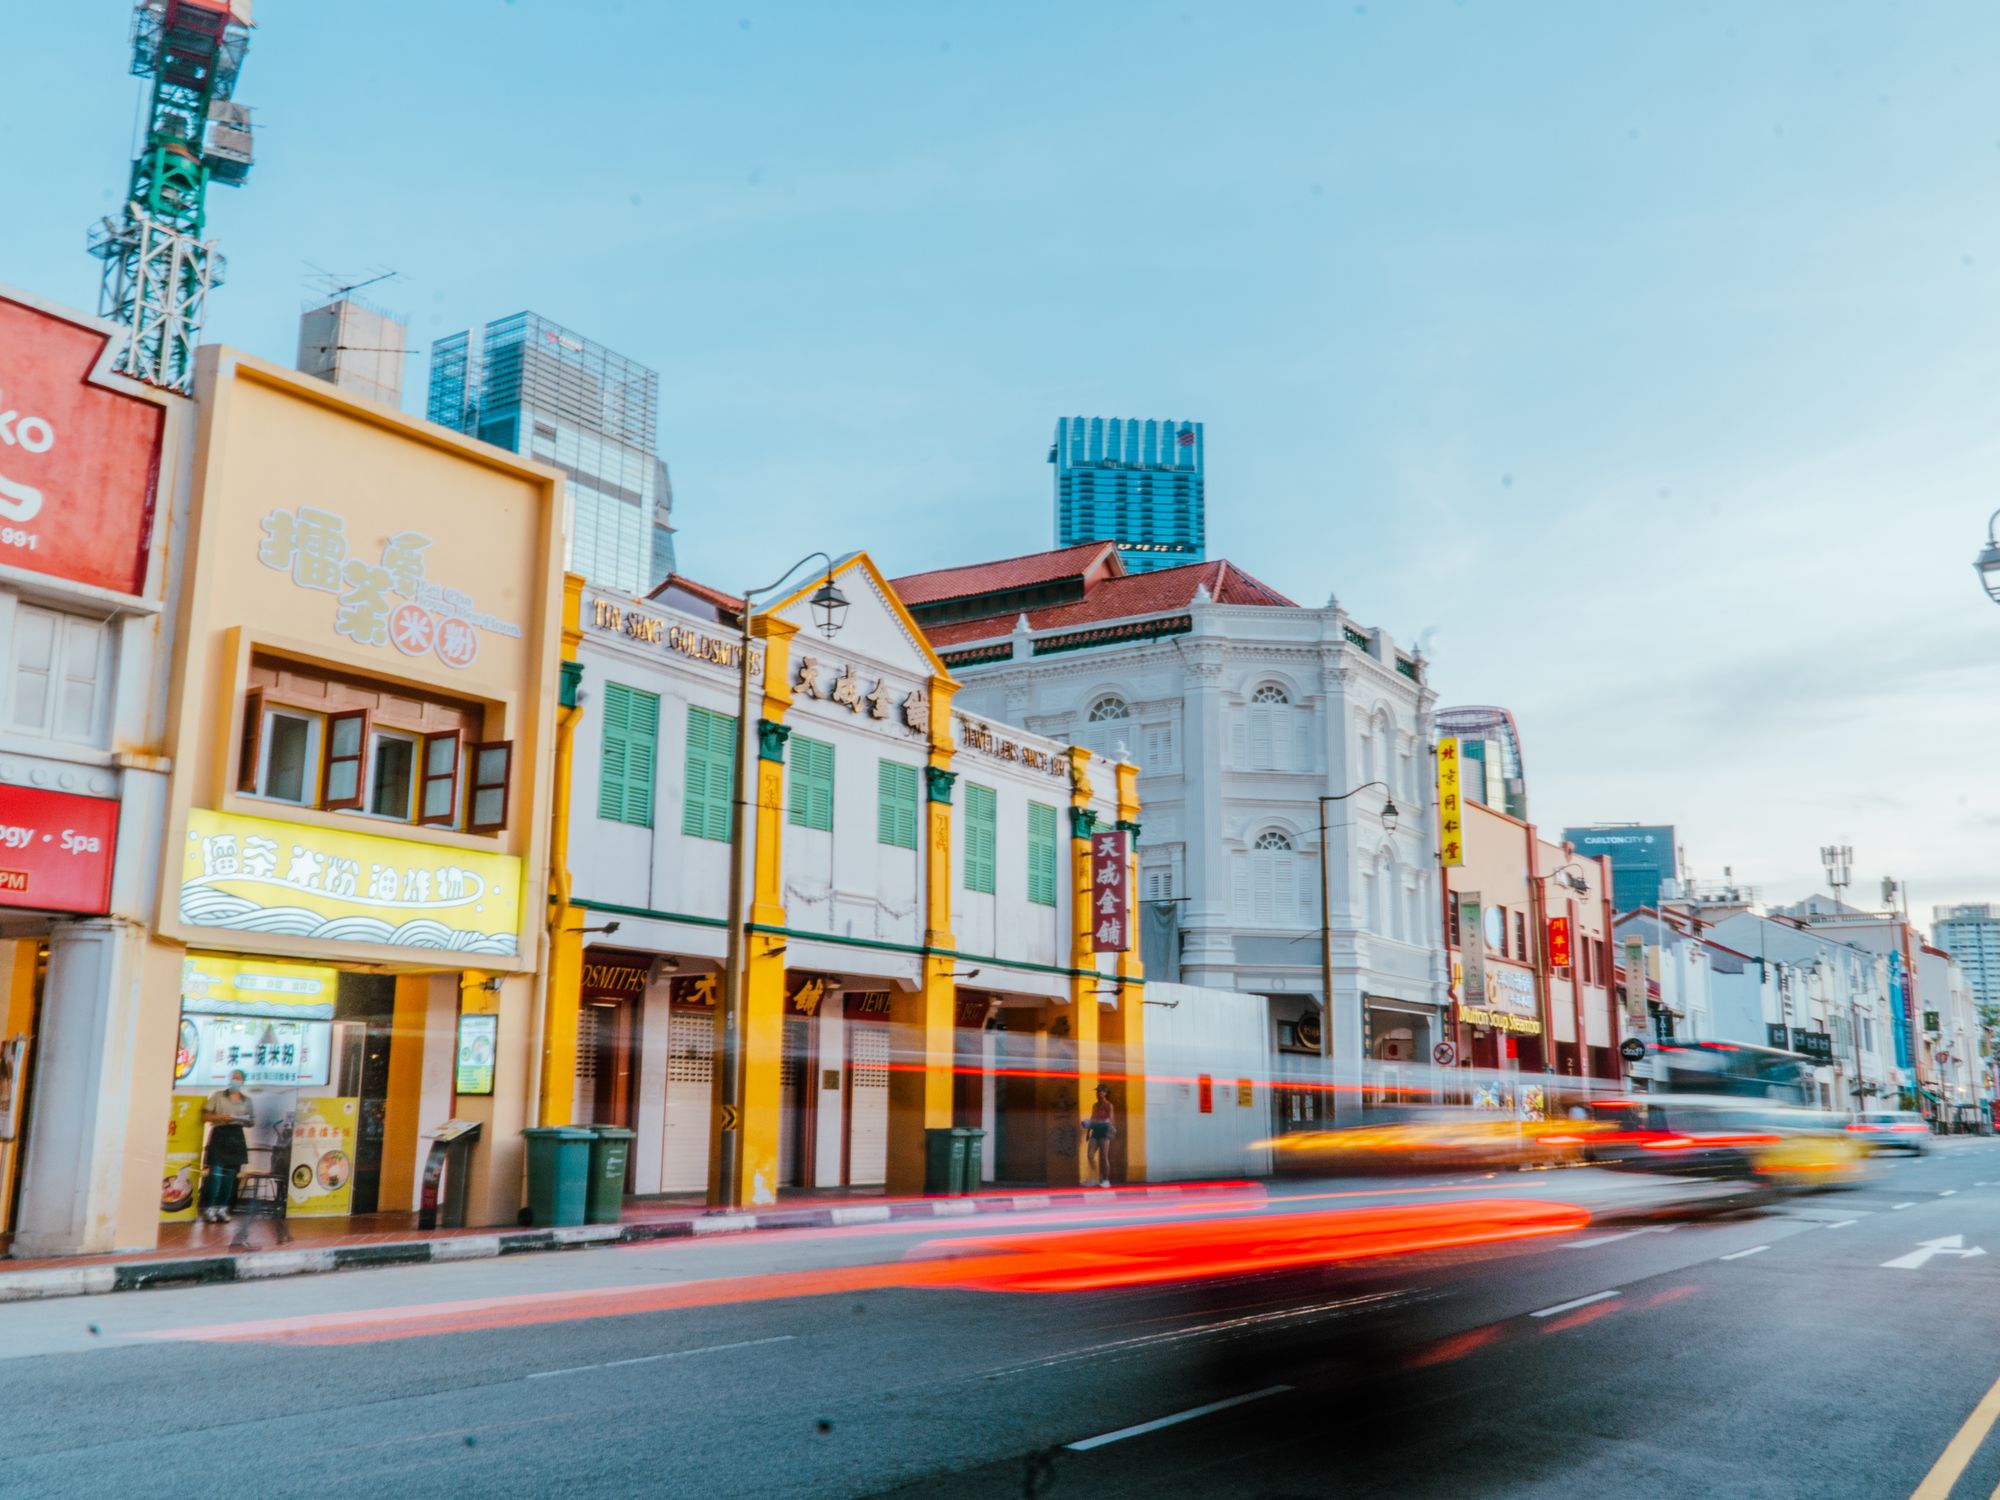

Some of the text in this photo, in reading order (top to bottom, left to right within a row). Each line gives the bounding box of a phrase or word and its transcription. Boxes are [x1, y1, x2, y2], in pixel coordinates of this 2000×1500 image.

[594, 598, 622, 632] TIN
[625, 612, 664, 645] SING
[60, 829, 101, 856] Spa
